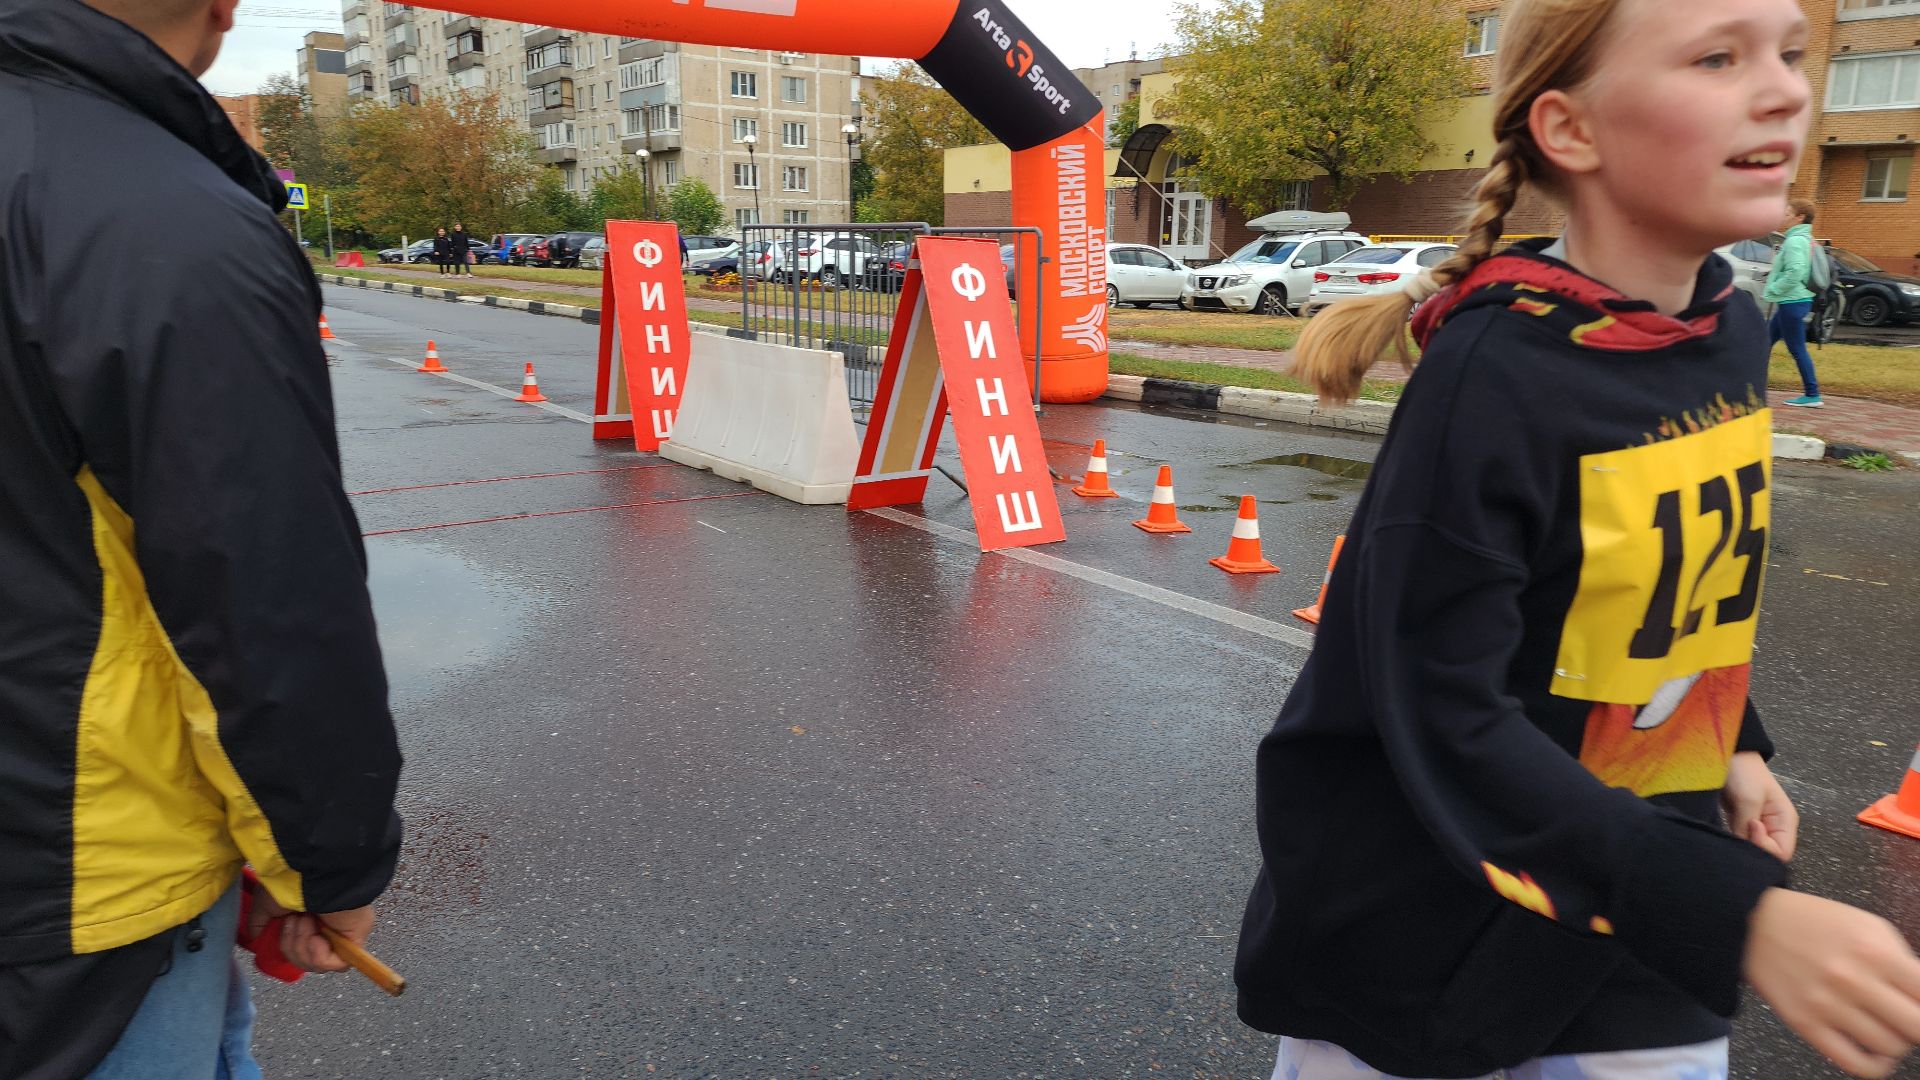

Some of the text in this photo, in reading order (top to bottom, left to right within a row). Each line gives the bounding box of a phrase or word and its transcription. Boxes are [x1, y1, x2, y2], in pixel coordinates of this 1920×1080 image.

[973, 8, 1071, 114] Arta Sport
[1050, 143, 1088, 298] МОСКОВСКИЙ
[1087, 225, 1106, 295] СПОРТ
[950, 262, 1043, 533] ФИНИШ
[1628, 460, 1767, 660] 125
